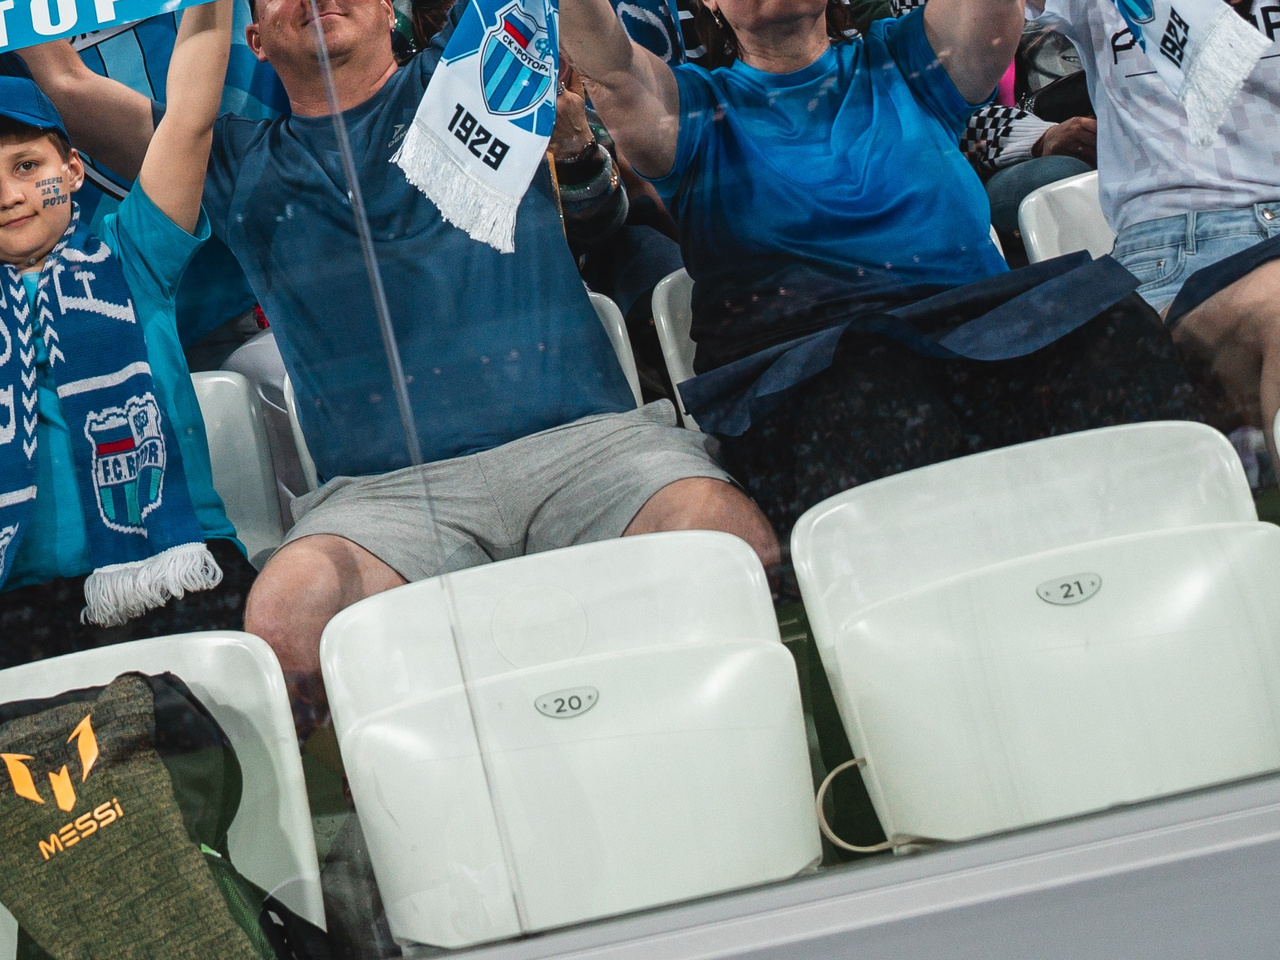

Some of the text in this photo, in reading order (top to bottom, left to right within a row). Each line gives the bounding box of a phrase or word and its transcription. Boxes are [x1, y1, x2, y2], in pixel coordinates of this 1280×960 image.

[502, 33, 515, 48] СК
[1160, 6, 1190, 69] 1929
[447, 102, 511, 172] 1929
[1060, 580, 1083, 599] 21
[554, 695, 582, 713] 20
